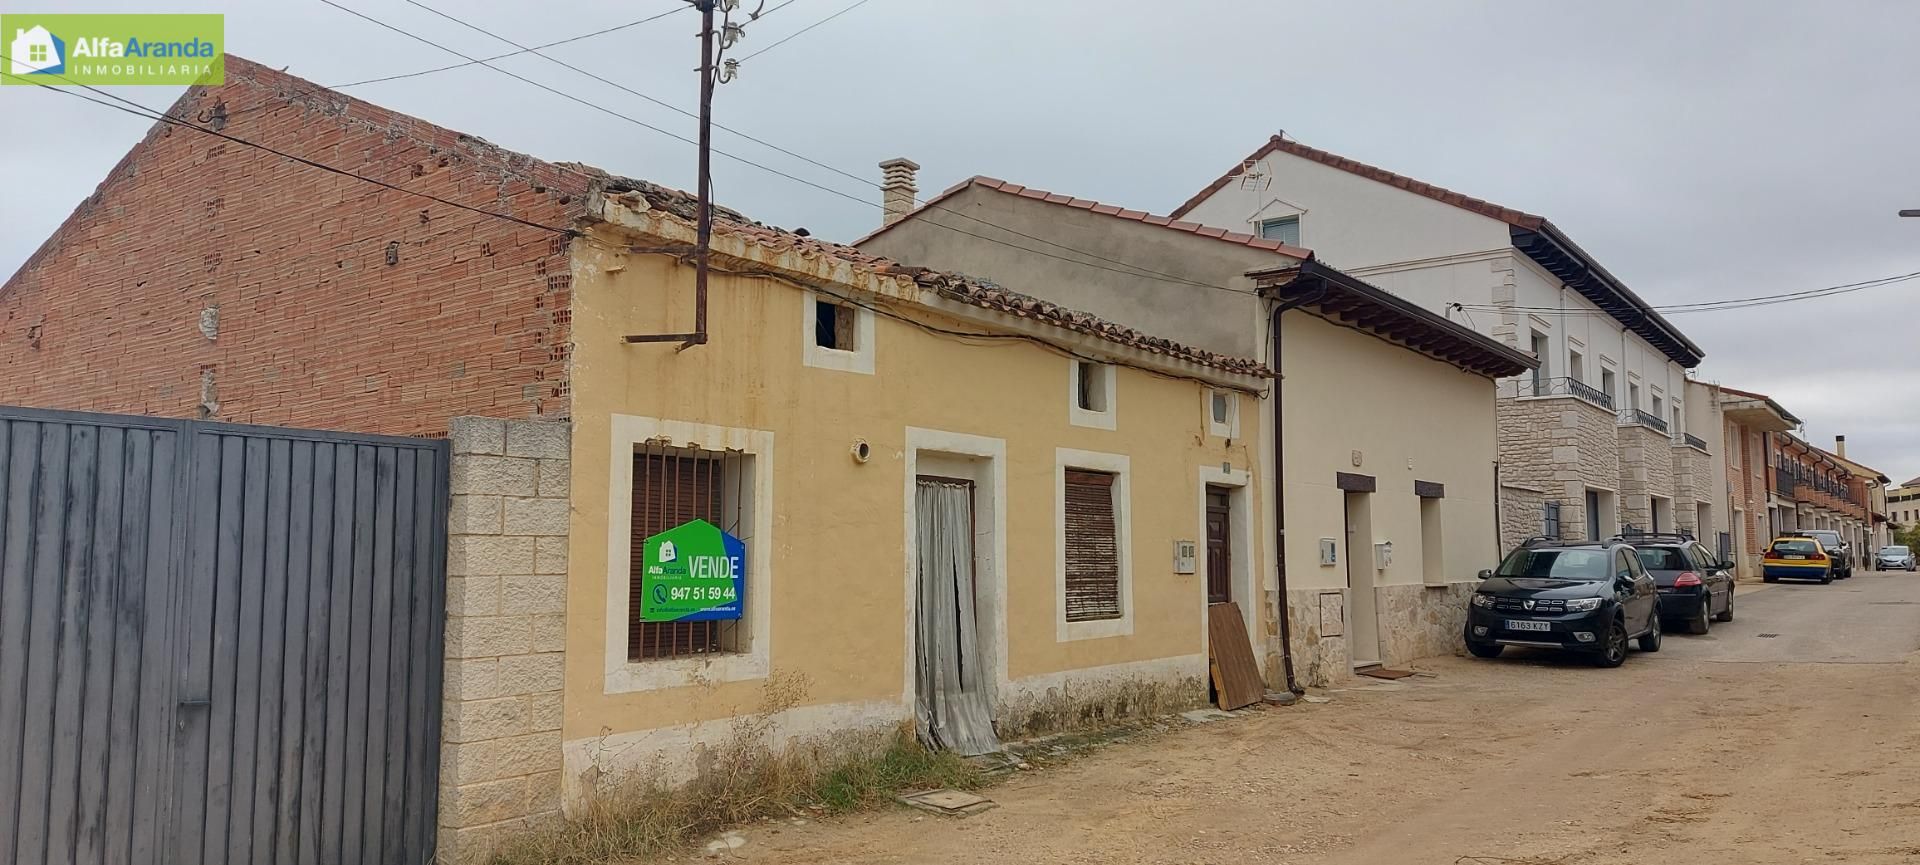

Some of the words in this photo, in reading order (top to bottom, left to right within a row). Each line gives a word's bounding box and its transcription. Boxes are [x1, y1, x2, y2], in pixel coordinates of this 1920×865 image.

[688, 555, 739, 579] VENDE
[671, 587, 691, 600] 947
[693, 587, 705, 600] 51
[708, 587, 721, 600] 59
[723, 587, 736, 600] 44
[1510, 621, 1531, 630] 6163
